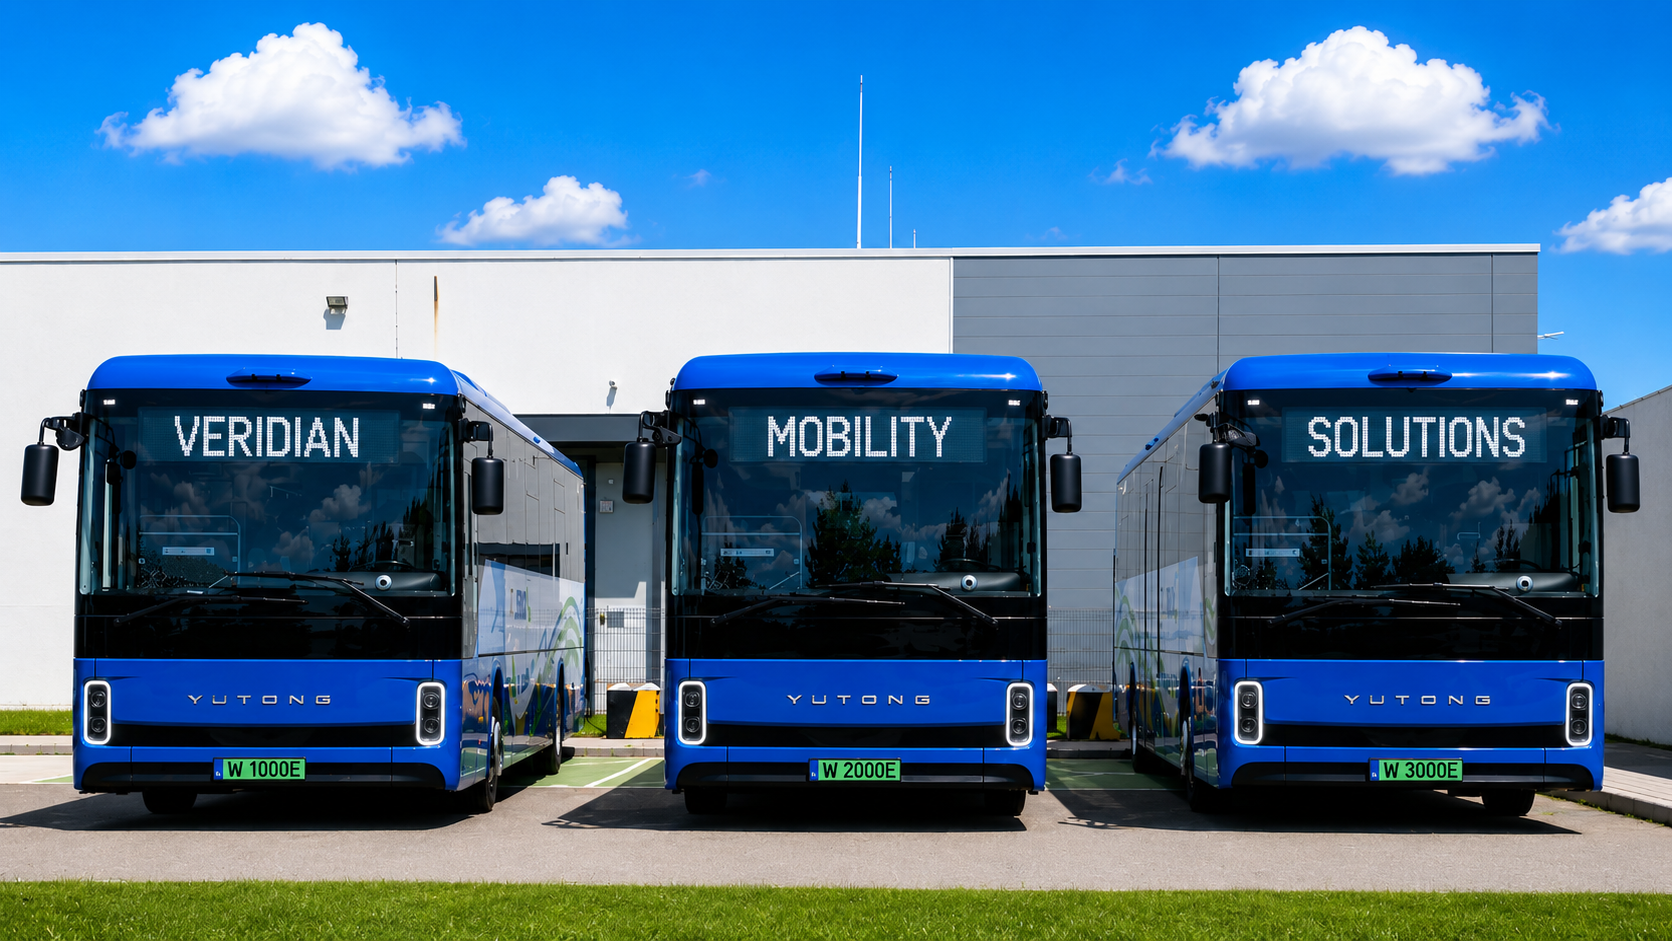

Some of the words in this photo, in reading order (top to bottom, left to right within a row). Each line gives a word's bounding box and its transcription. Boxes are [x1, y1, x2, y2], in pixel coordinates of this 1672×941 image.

[174, 415, 359, 458] VERIDIAN
[767, 416, 952, 458] MOBILITY
[1308, 416, 1526, 458] SOLUTIONS
[187, 694, 332, 705] YUTONG
[786, 694, 931, 705] YUTONG
[1344, 694, 1491, 705] YUTONG
[227, 761, 243, 777] W
[249, 761, 301, 777] 1000E
[822, 762, 838, 778] W
[843, 762, 896, 778] 2000E
[1383, 762, 1400, 778] W
[1405, 762, 1458, 778] 3000E
